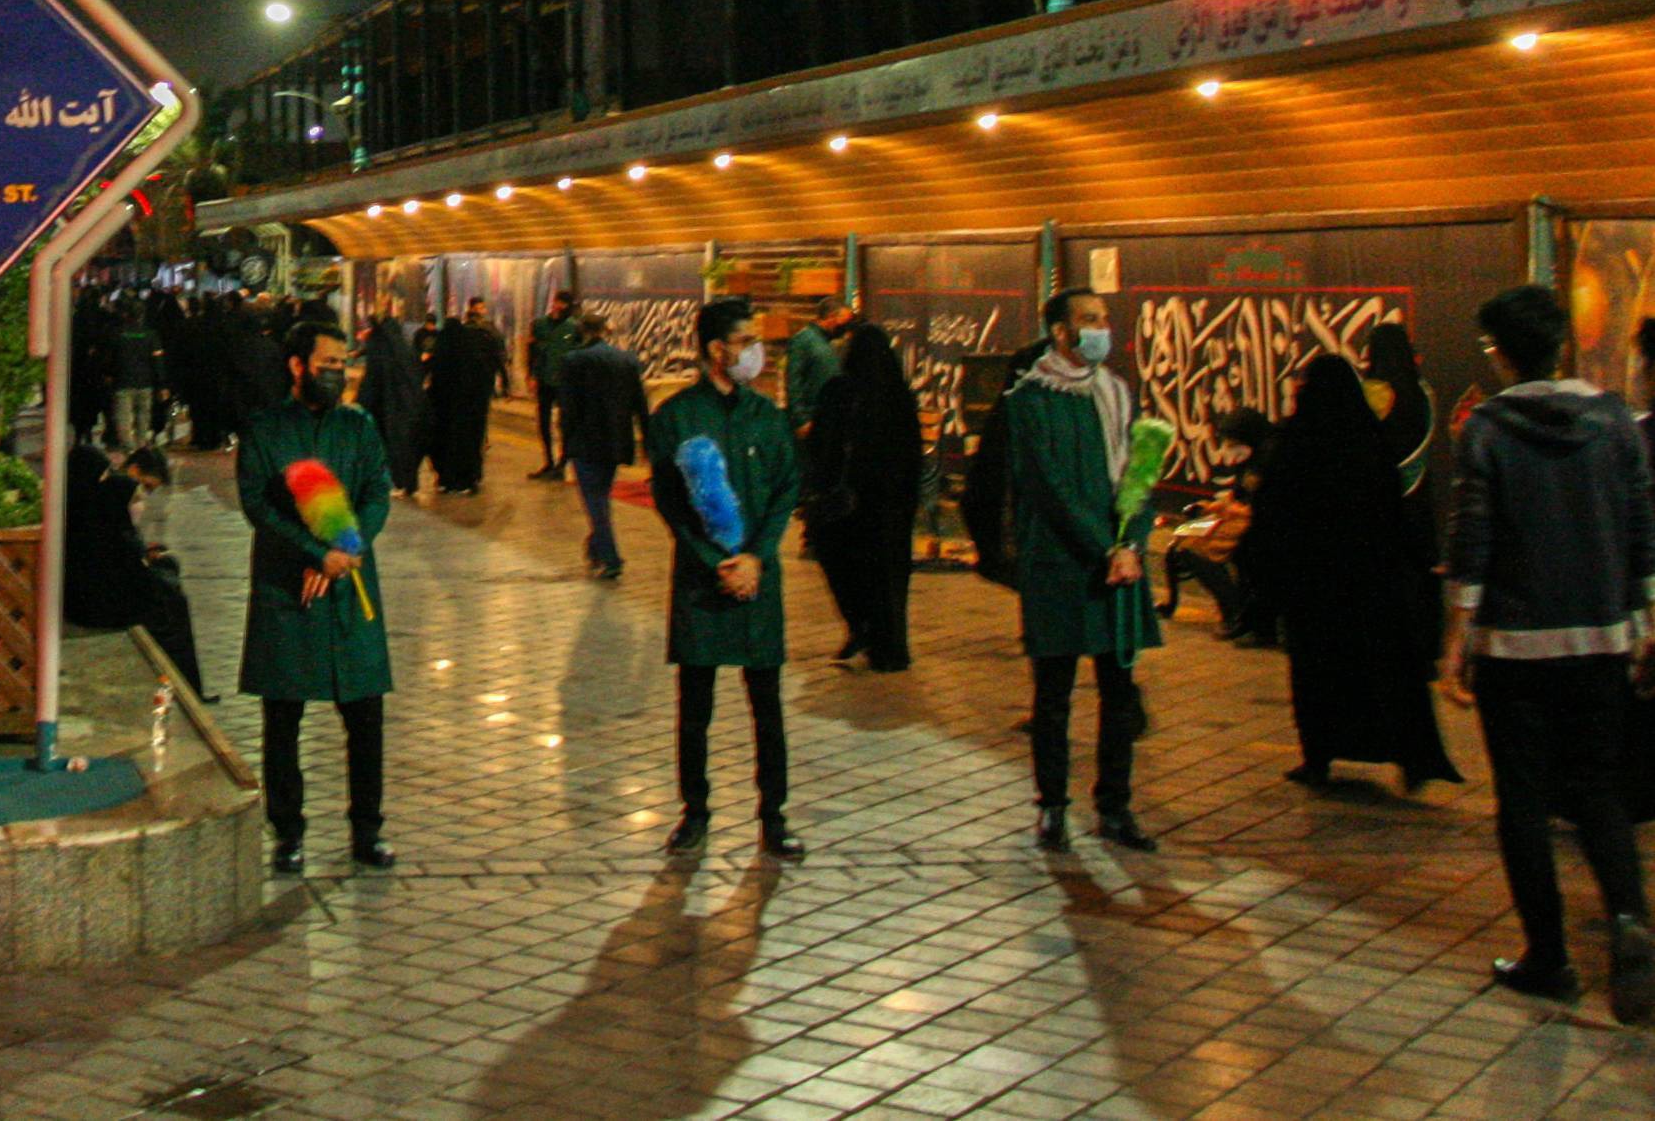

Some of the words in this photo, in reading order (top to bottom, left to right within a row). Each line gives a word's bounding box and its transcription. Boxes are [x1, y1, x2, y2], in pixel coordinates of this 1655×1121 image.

[4, 88, 52, 128] الله
[58, 88, 118, 132] آیت
[3, 184, 37, 203] ST.
